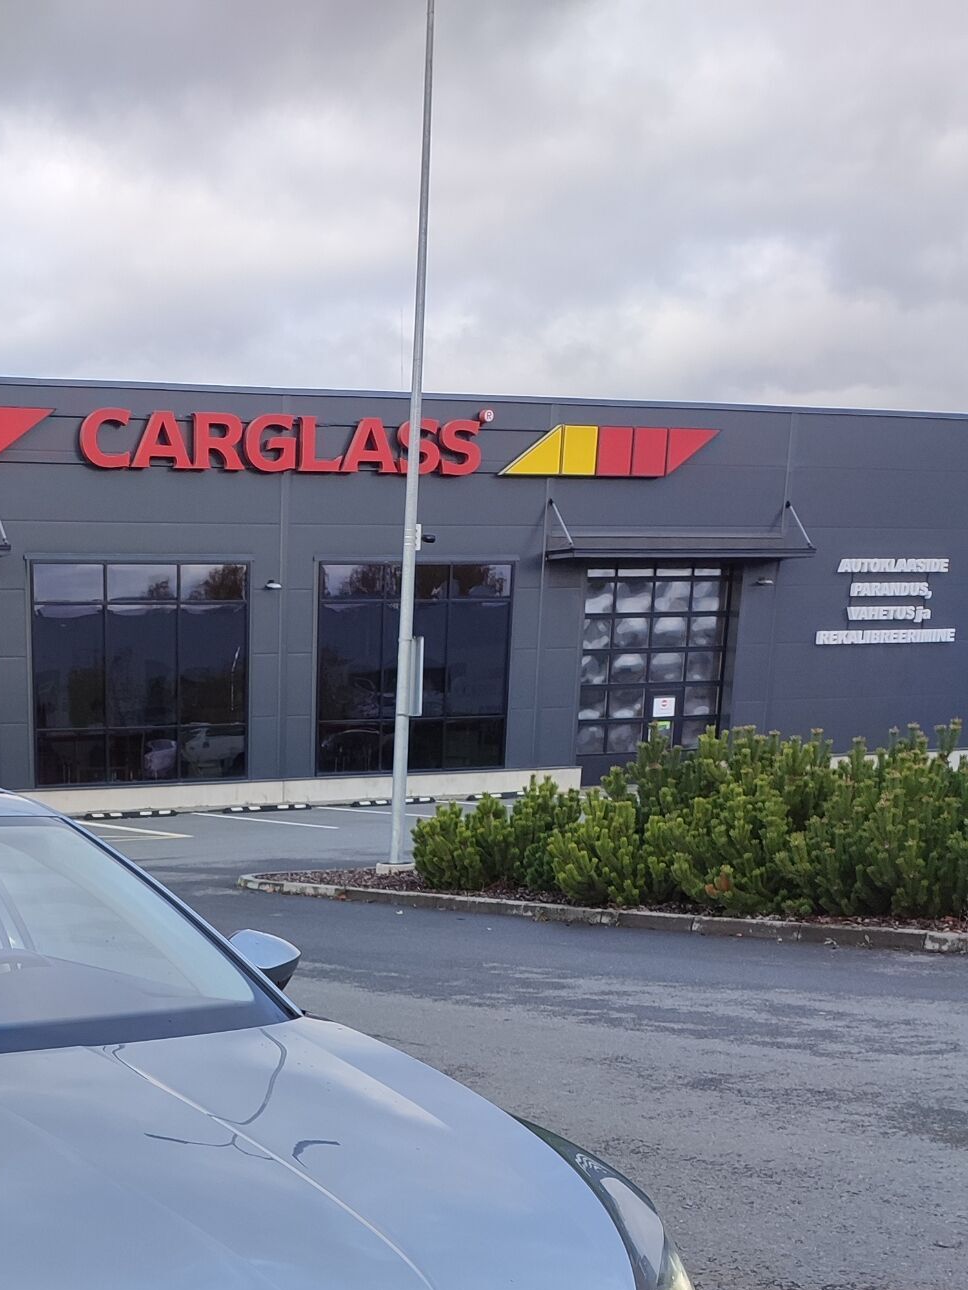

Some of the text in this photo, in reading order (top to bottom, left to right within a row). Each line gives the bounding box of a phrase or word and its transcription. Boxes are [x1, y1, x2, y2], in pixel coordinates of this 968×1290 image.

[837, 558, 950, 573] AUTOKLAASIDE
[850, 581, 932, 600] PARANDUS,
[847, 605, 932, 623] VAHETUS ja
[815, 628, 956, 645] REKALIBREERIMINE
